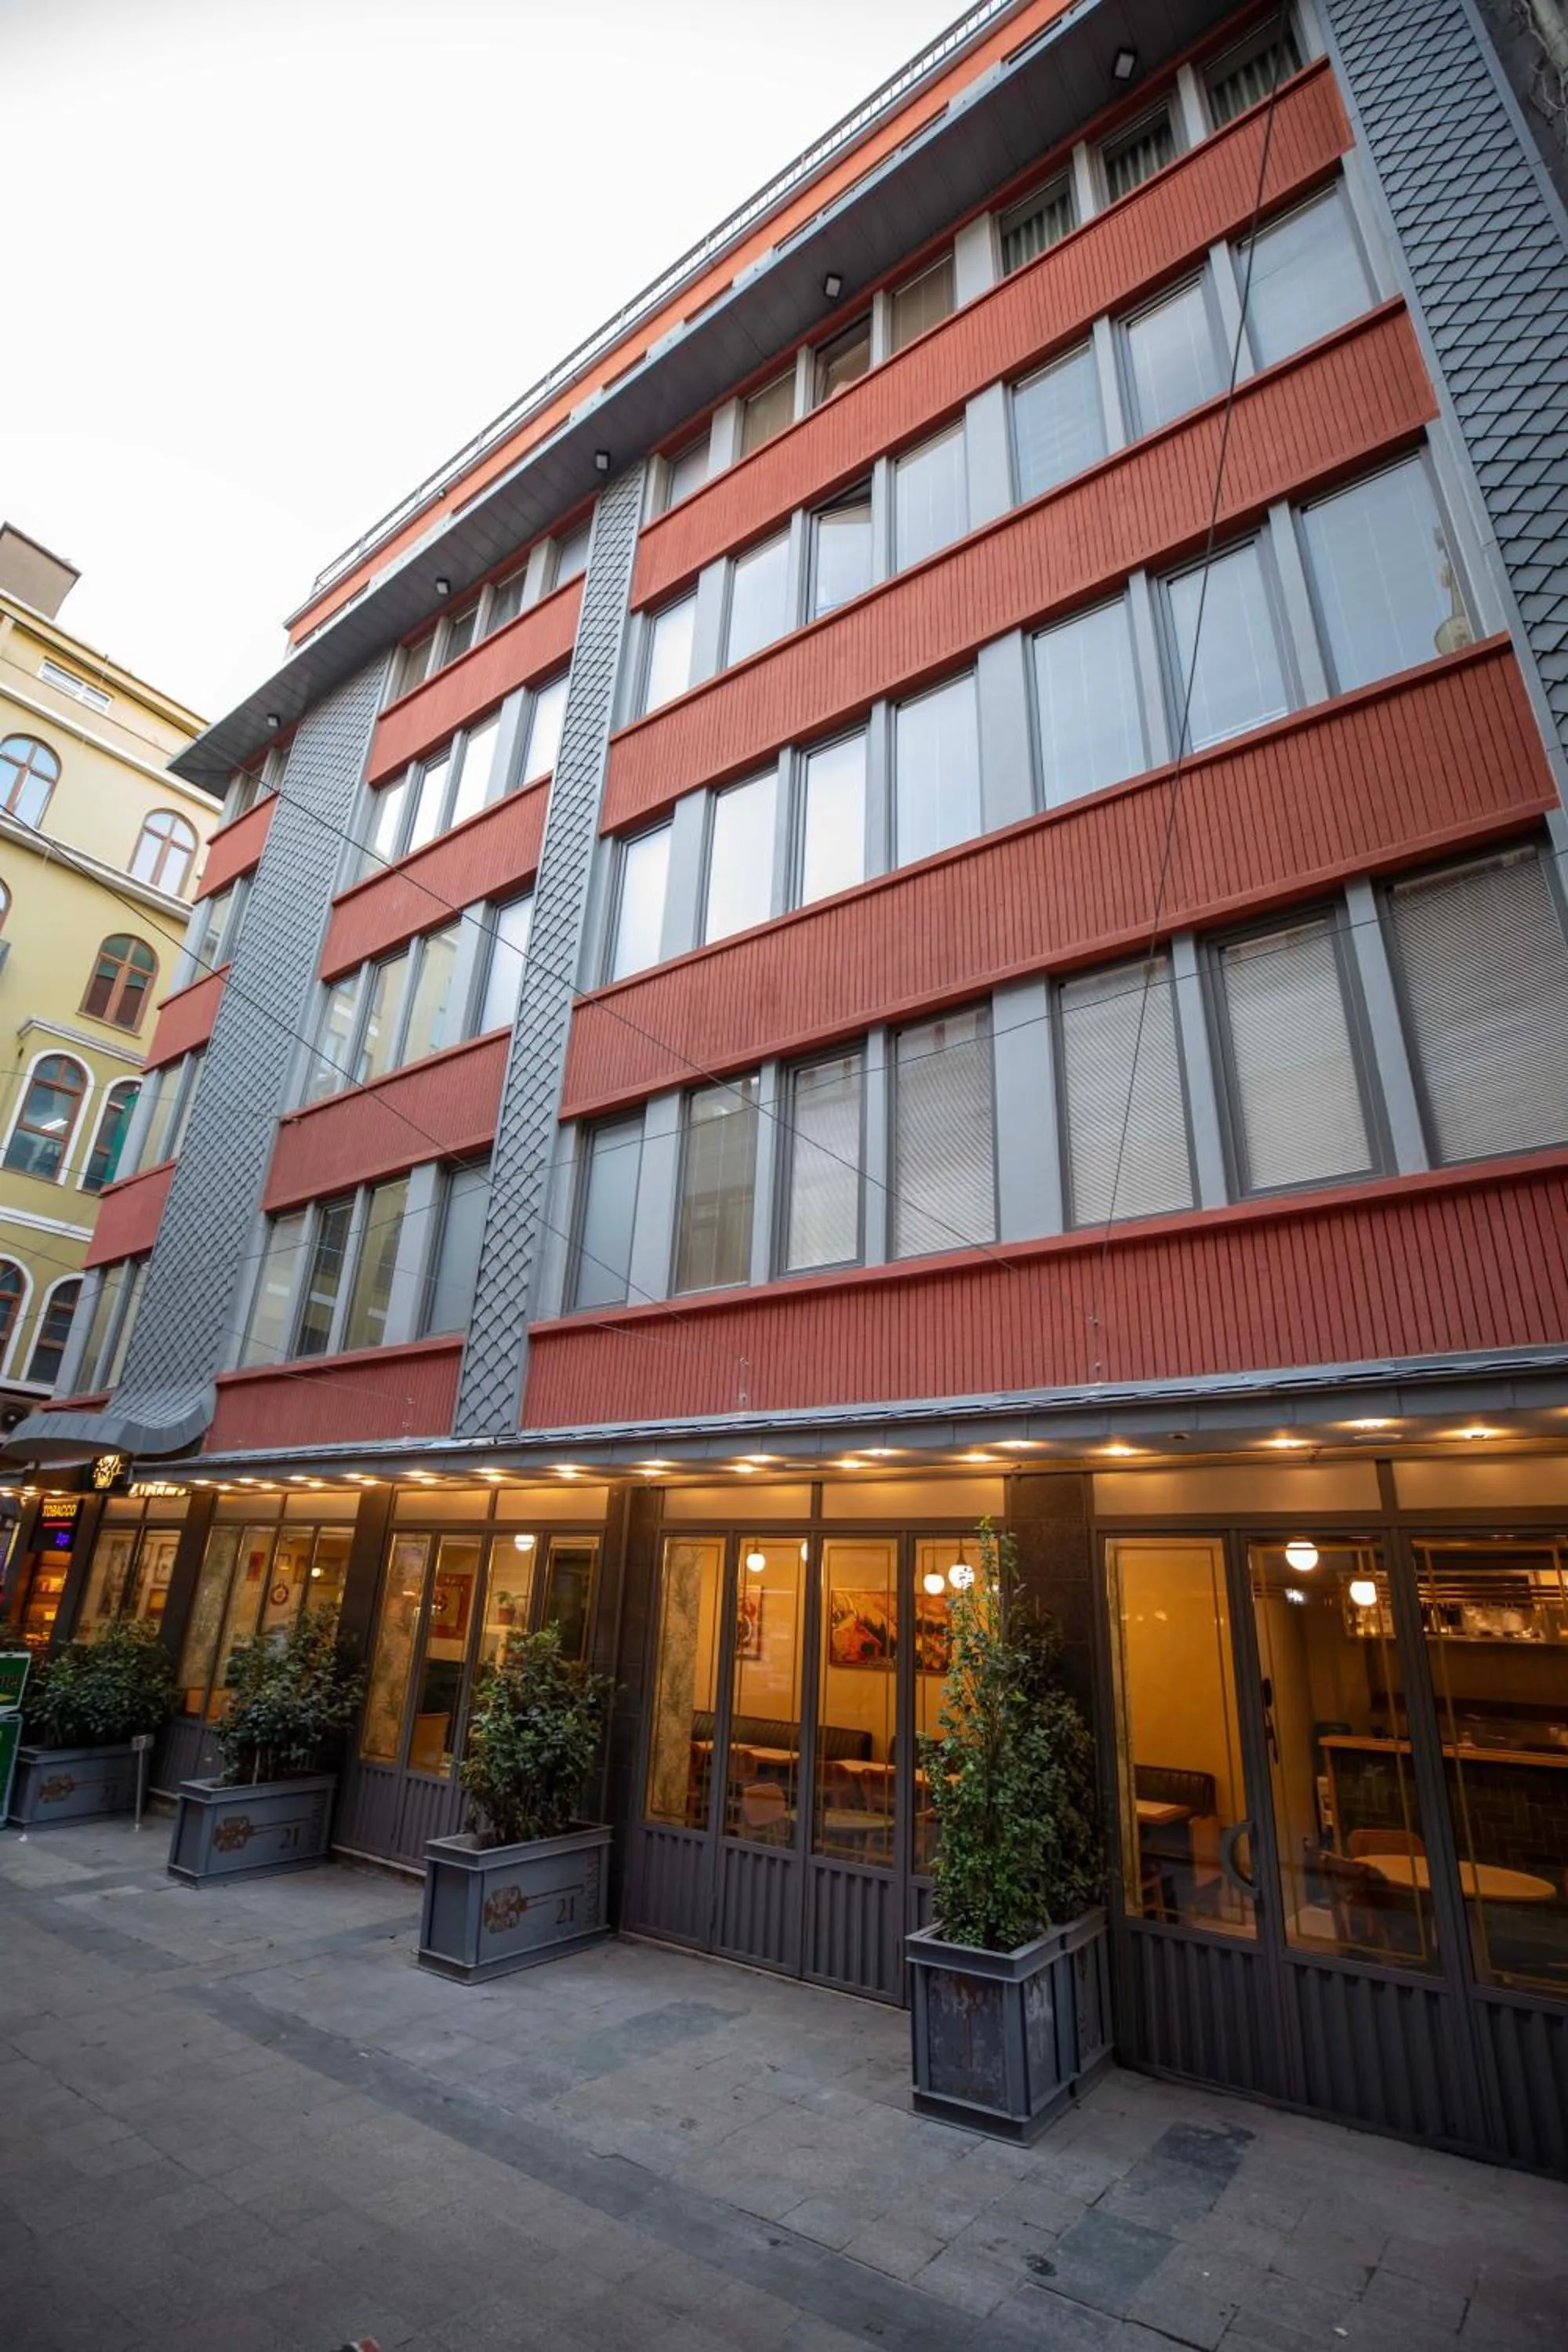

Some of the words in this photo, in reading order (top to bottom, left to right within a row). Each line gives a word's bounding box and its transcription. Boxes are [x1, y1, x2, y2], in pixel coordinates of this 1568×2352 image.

[42, 1504, 77, 1517] TOBACCO
[279, 1828, 299, 1849] 21
[555, 1896, 575, 1925] 21
